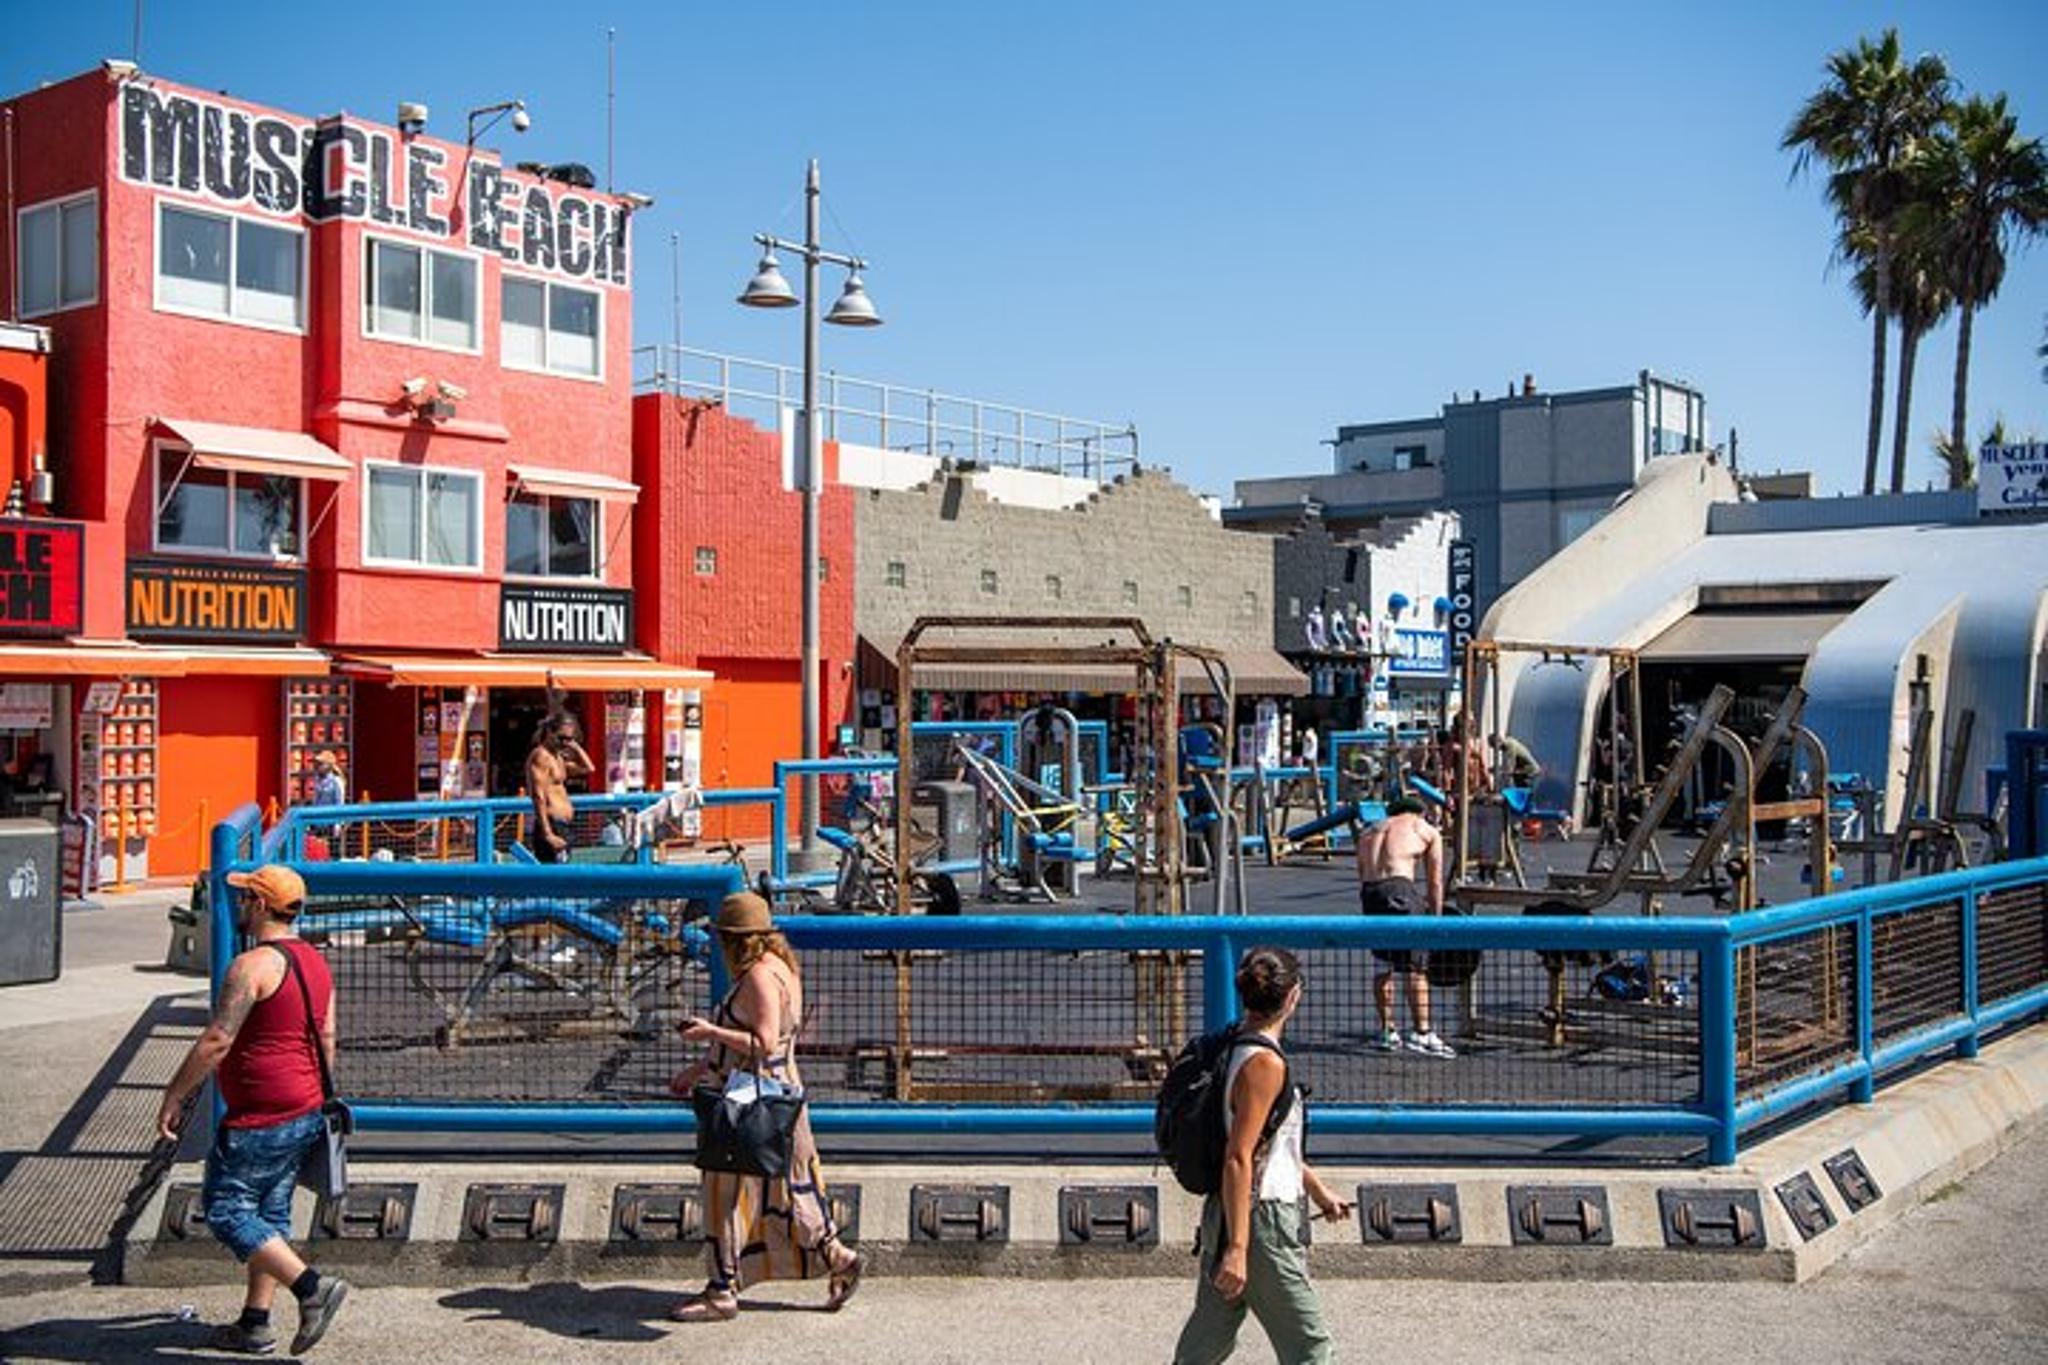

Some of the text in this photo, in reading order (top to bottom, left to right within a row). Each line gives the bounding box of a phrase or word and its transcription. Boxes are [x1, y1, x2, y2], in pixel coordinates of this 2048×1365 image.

[122, 82, 628, 285] MUSCLE BEACH
[131, 578, 295, 630] NUTRITION
[505, 599, 624, 643] NUTRITION
[1453, 573, 1472, 647] FOOD
